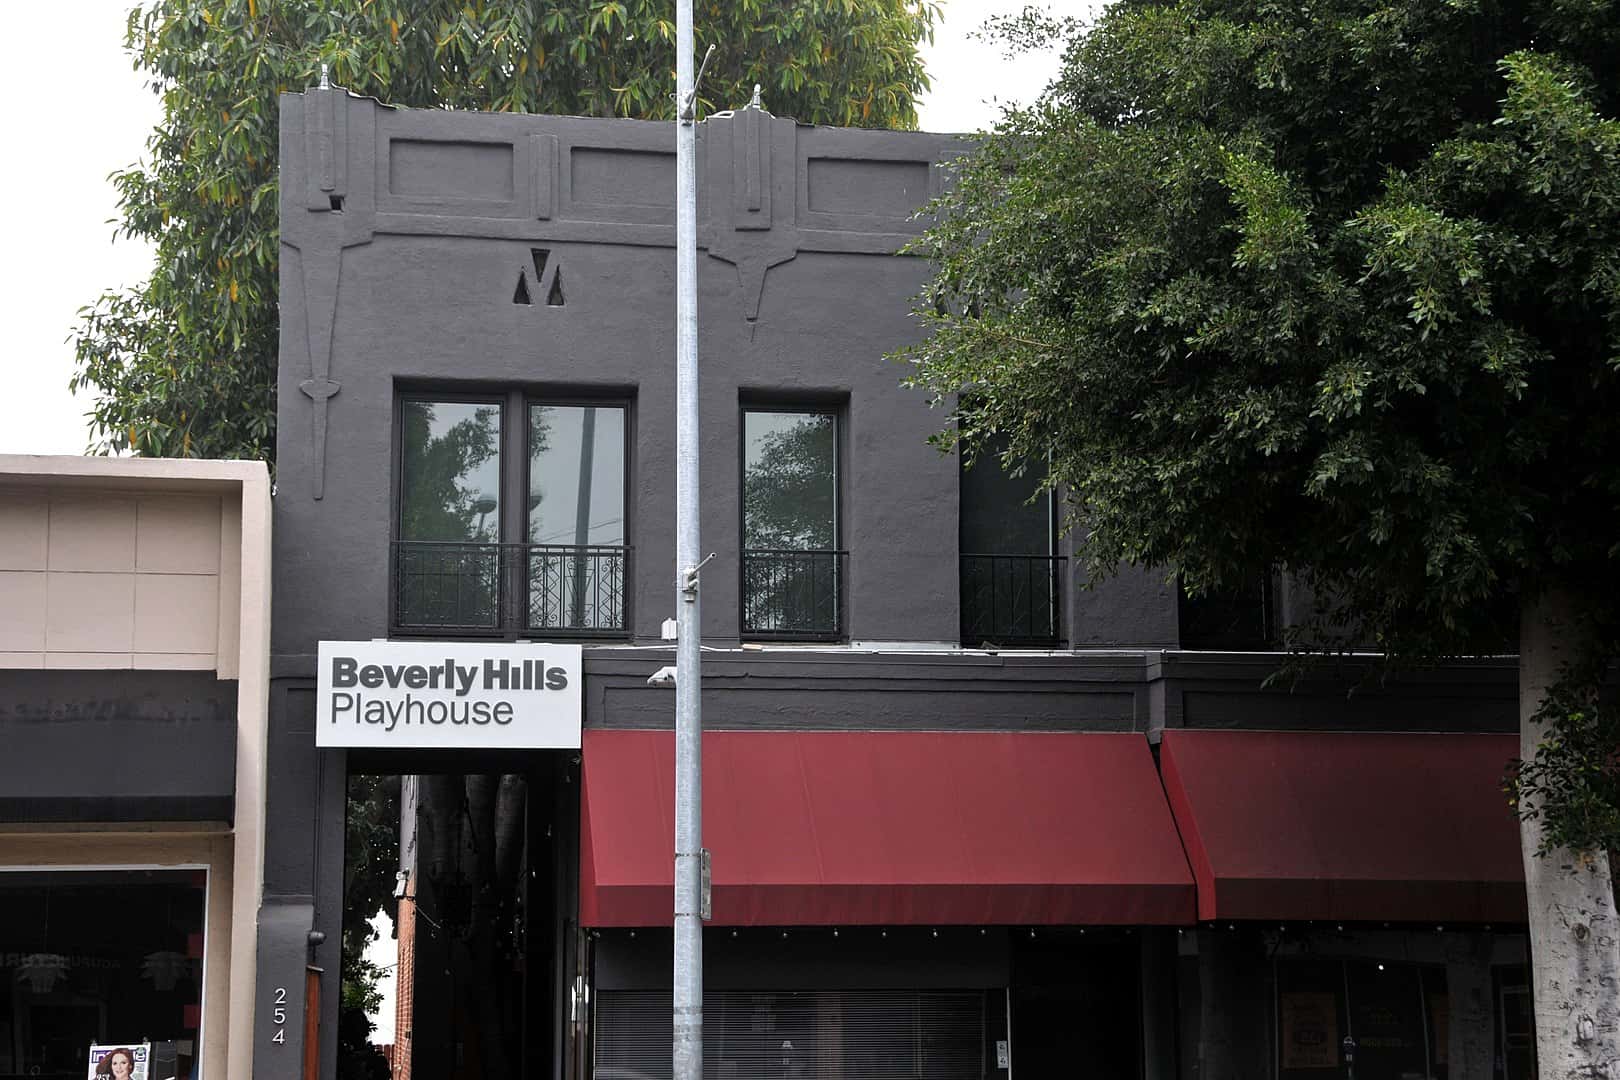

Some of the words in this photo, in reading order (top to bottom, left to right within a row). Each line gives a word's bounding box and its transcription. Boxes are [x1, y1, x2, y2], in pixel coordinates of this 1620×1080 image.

[332, 657, 479, 697] Beverly
[483, 659, 568, 691] Hills
[332, 692, 514, 732] Playhouse
[272, 988, 286, 1044] 254
